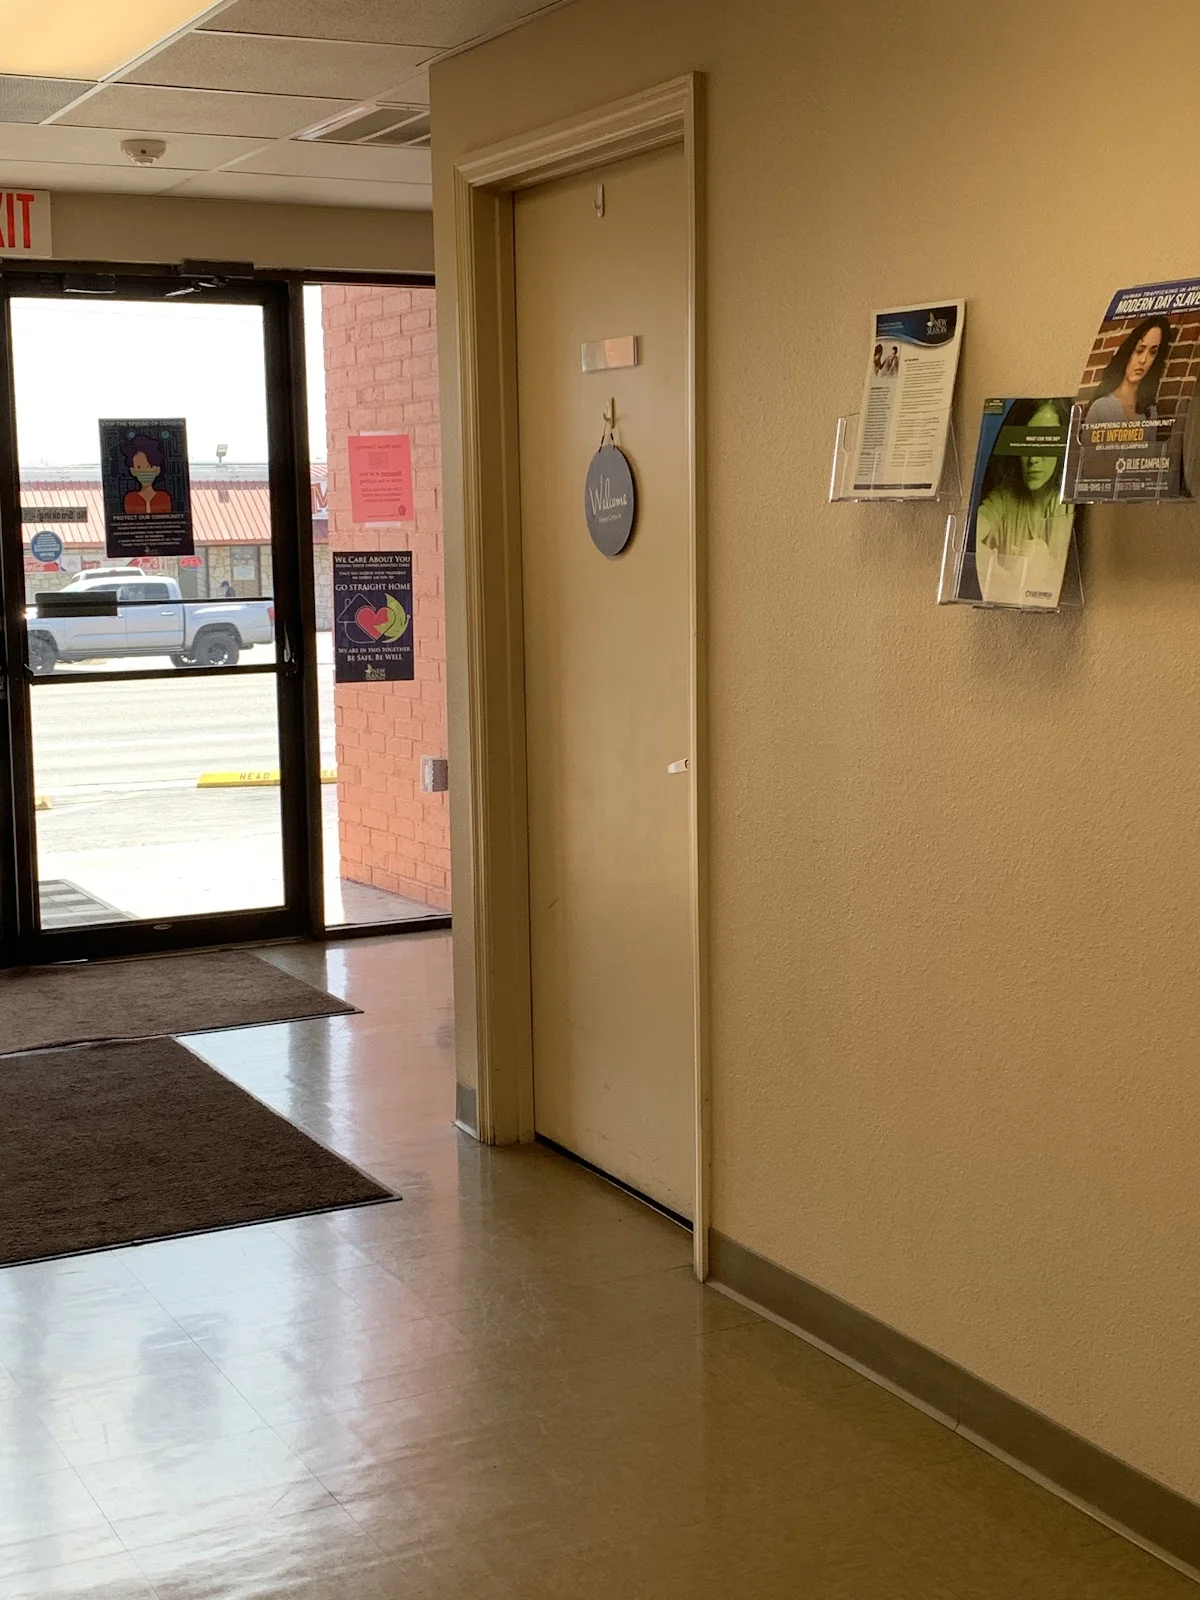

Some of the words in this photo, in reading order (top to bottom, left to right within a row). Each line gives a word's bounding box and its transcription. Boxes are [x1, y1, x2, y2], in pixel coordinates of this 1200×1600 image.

[1115, 297, 1156, 314] MODERN
[1154, 294, 1176, 309] DAY
[934, 318, 948, 326] NEW
[926, 326, 947, 335] SEASON
[1128, 420, 1140, 428] OUR
[1091, 431, 1105, 443] GET
[1106, 429, 1144, 442] INFORMED
[1126, 458, 1140, 470] BLUE
[588, 474, 628, 515] Welcome
[348, 555, 367, 563] CARE
[349, 583, 387, 591] STRAIGHT
[388, 582, 411, 590] HOME
[347, 654, 356, 662] BE
[239, 772, 270, 781] HEAD
